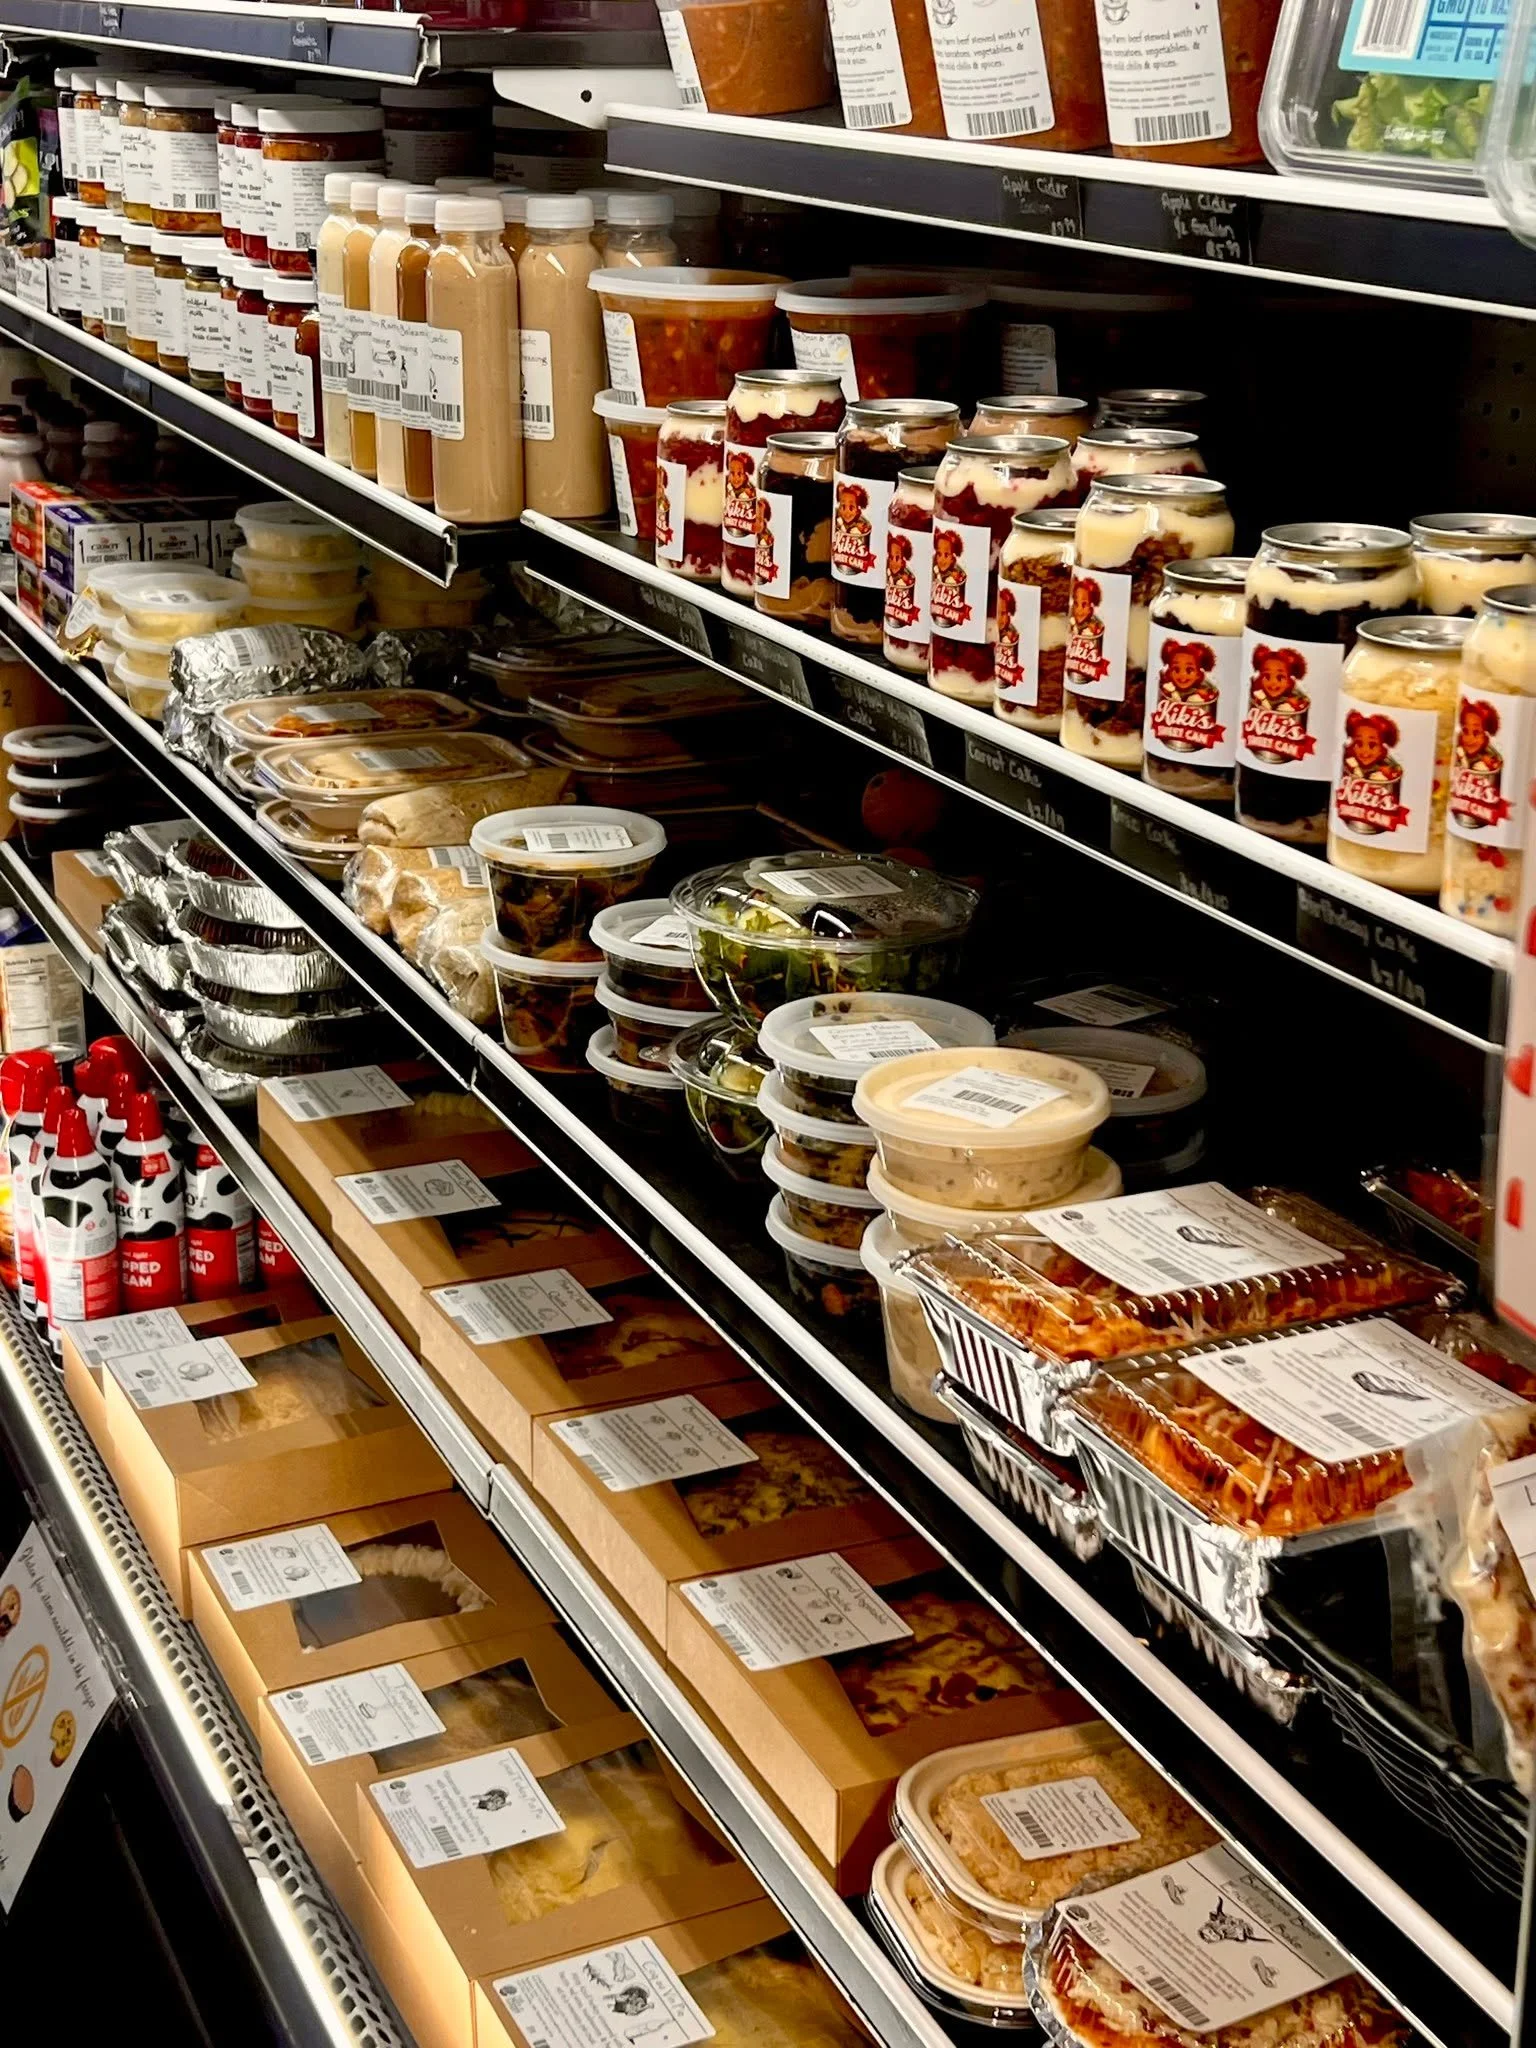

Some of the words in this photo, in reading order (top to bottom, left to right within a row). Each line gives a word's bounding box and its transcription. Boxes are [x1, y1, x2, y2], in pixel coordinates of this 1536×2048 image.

[1019, 27, 1031, 37] VT
[1195, 25, 1208, 35] VT
[1036, 177, 1069, 198] Cider
[1161, 192, 1192, 216] Apple
[1198, 193, 1237, 214] Cider
[1155, 699, 1215, 730] Kiki's
[1245, 707, 1306, 741] Kiki's
[1185, 728, 1209, 745] CAN
[1273, 739, 1300, 757] CAN
[967, 740, 1005, 774] Carrot
[1009, 759, 1043, 789] Cake
[1337, 775, 1398, 811] Kiki's
[1366, 810, 1392, 828] CAN
[1267, 1922, 1308, 1951] Bake
[670, 2002, 691, 2018] Pie
